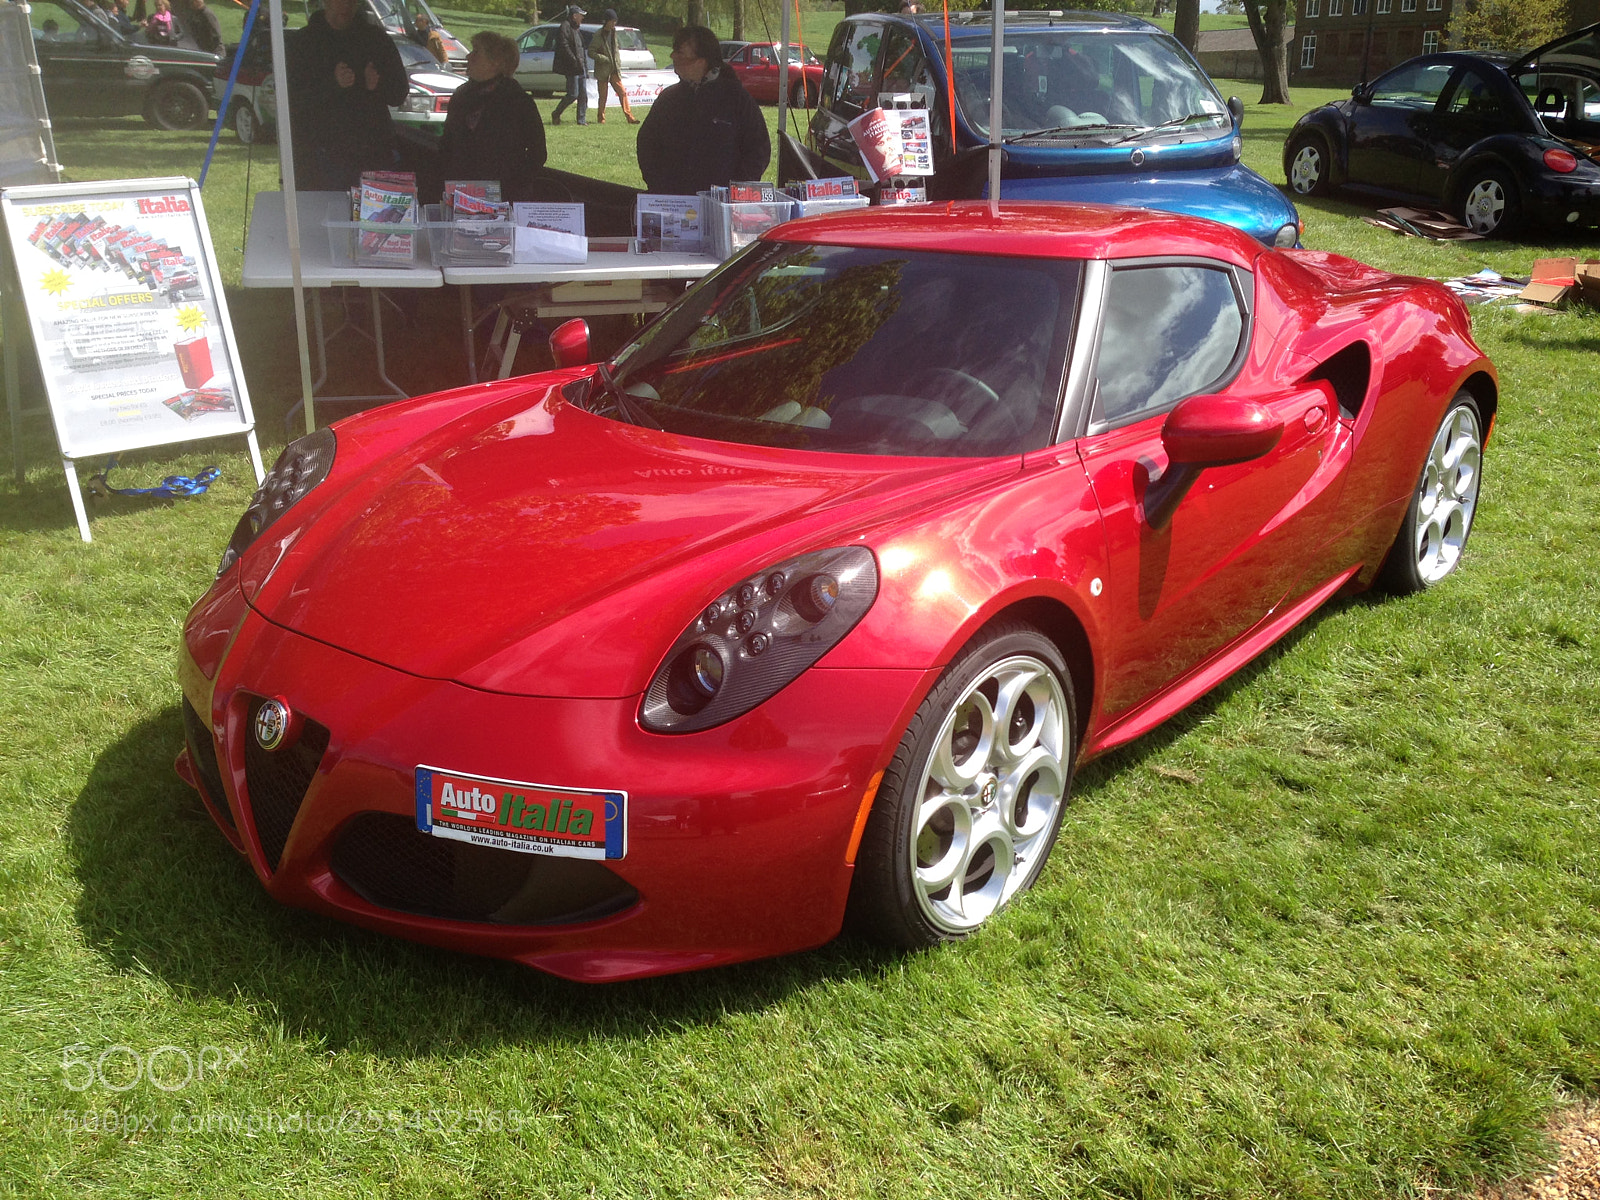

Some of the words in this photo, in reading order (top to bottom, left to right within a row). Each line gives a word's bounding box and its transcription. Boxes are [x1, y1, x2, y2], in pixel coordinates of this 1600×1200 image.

[364, 190, 383, 202] Auto
[383, 194, 411, 205] Italia
[731, 185, 762, 201] Italia
[762, 193, 774, 201] 159
[808, 182, 842, 197] Italia
[881, 189, 911, 199] Italia
[22, 204, 86, 217] SUBSCRIBE
[89, 201, 124, 212] TODAY
[137, 196, 190, 214] Italia
[459, 196, 494, 214] Italia
[57, 298, 106, 311] SPECIAL
[108, 292, 154, 306] OFFERS
[440, 782, 497, 814] Auto
[498, 792, 594, 835] Italia
[440, 820, 450, 828] THE
[451, 823, 477, 832] WORLD'S
[479, 828, 504, 837] LEADING
[506, 832, 537, 841] MAGAZINE
[550, 838, 576, 846] ITALIAN
[471, 835, 554, 854] www.auto-italia.co.uk
